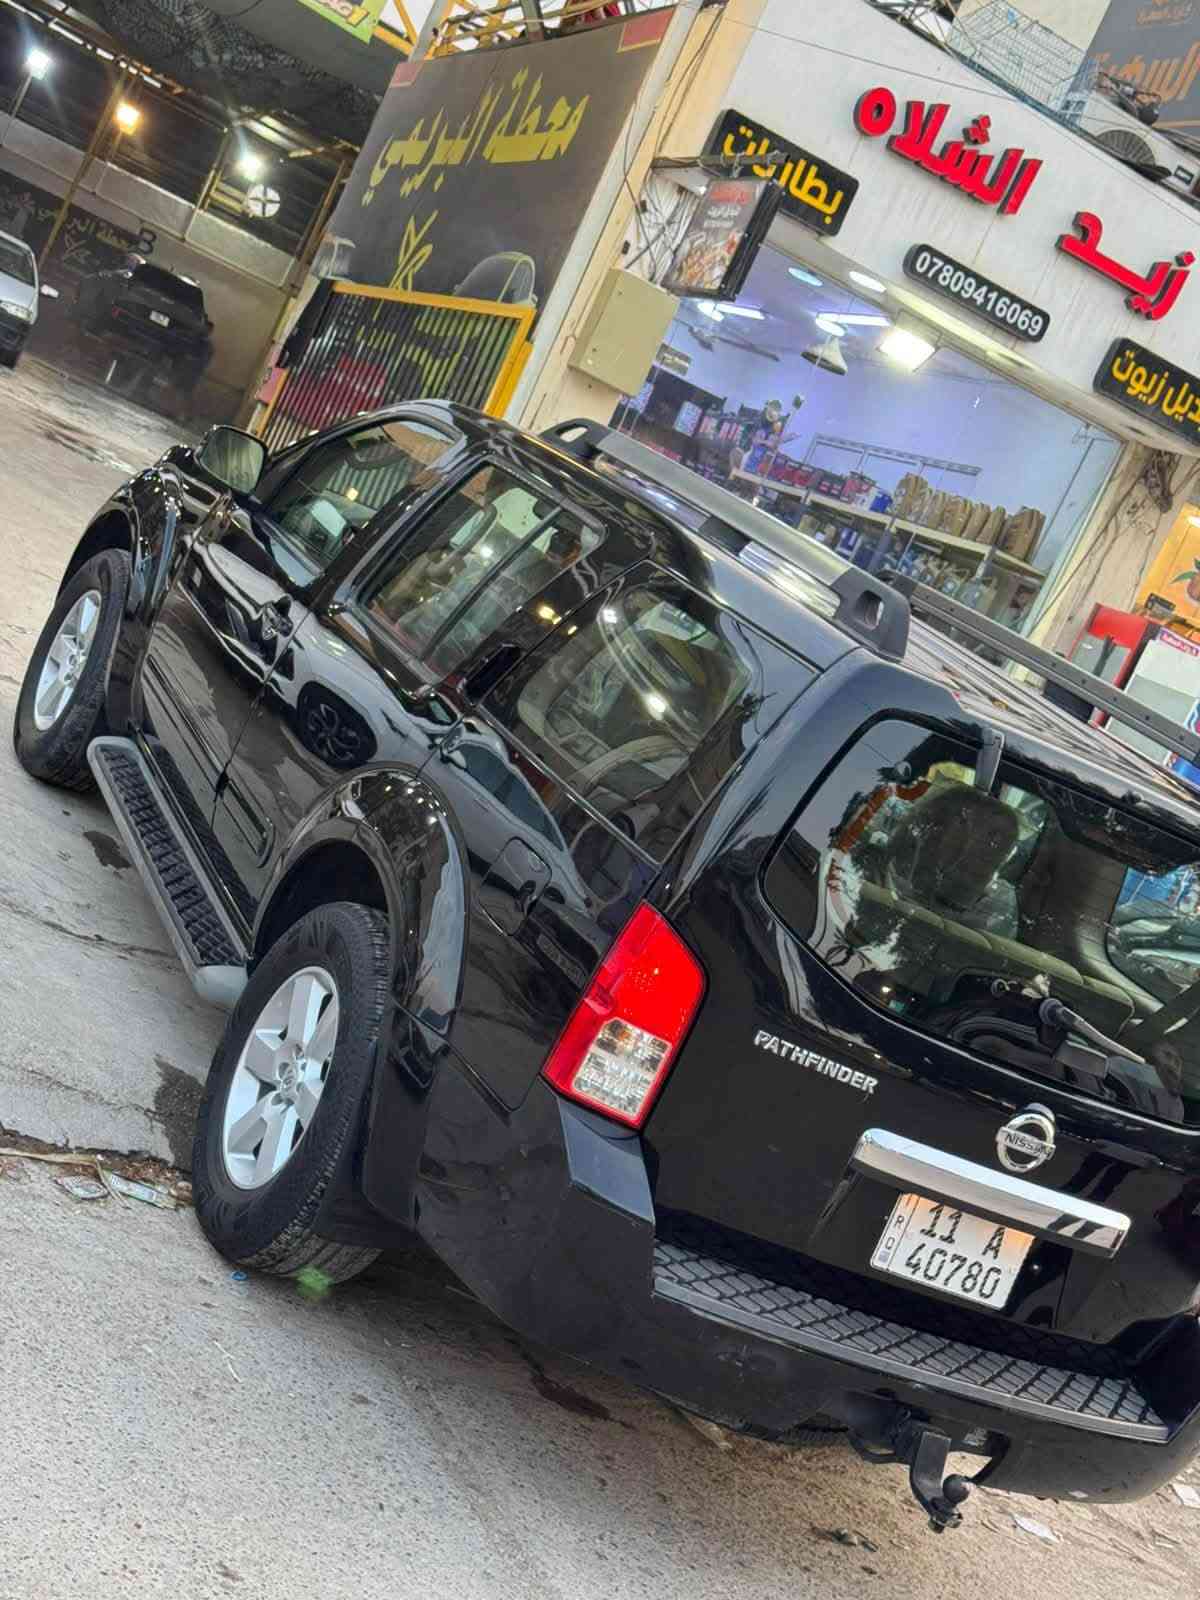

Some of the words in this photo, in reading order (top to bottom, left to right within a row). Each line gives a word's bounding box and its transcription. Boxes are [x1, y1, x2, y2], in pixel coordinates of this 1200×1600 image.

[853, 86, 1044, 217] الشلاه
[914, 251, 1044, 338] 07809416069
[1055, 211, 1197, 321] زيد
[1111, 350, 1169, 405] زيوت
[753, 1029, 879, 1095] PATHFINDER
[920, 1203, 963, 1244] 11
[981, 1226, 1007, 1260] A
[904, 1243, 1003, 1299] 40780
